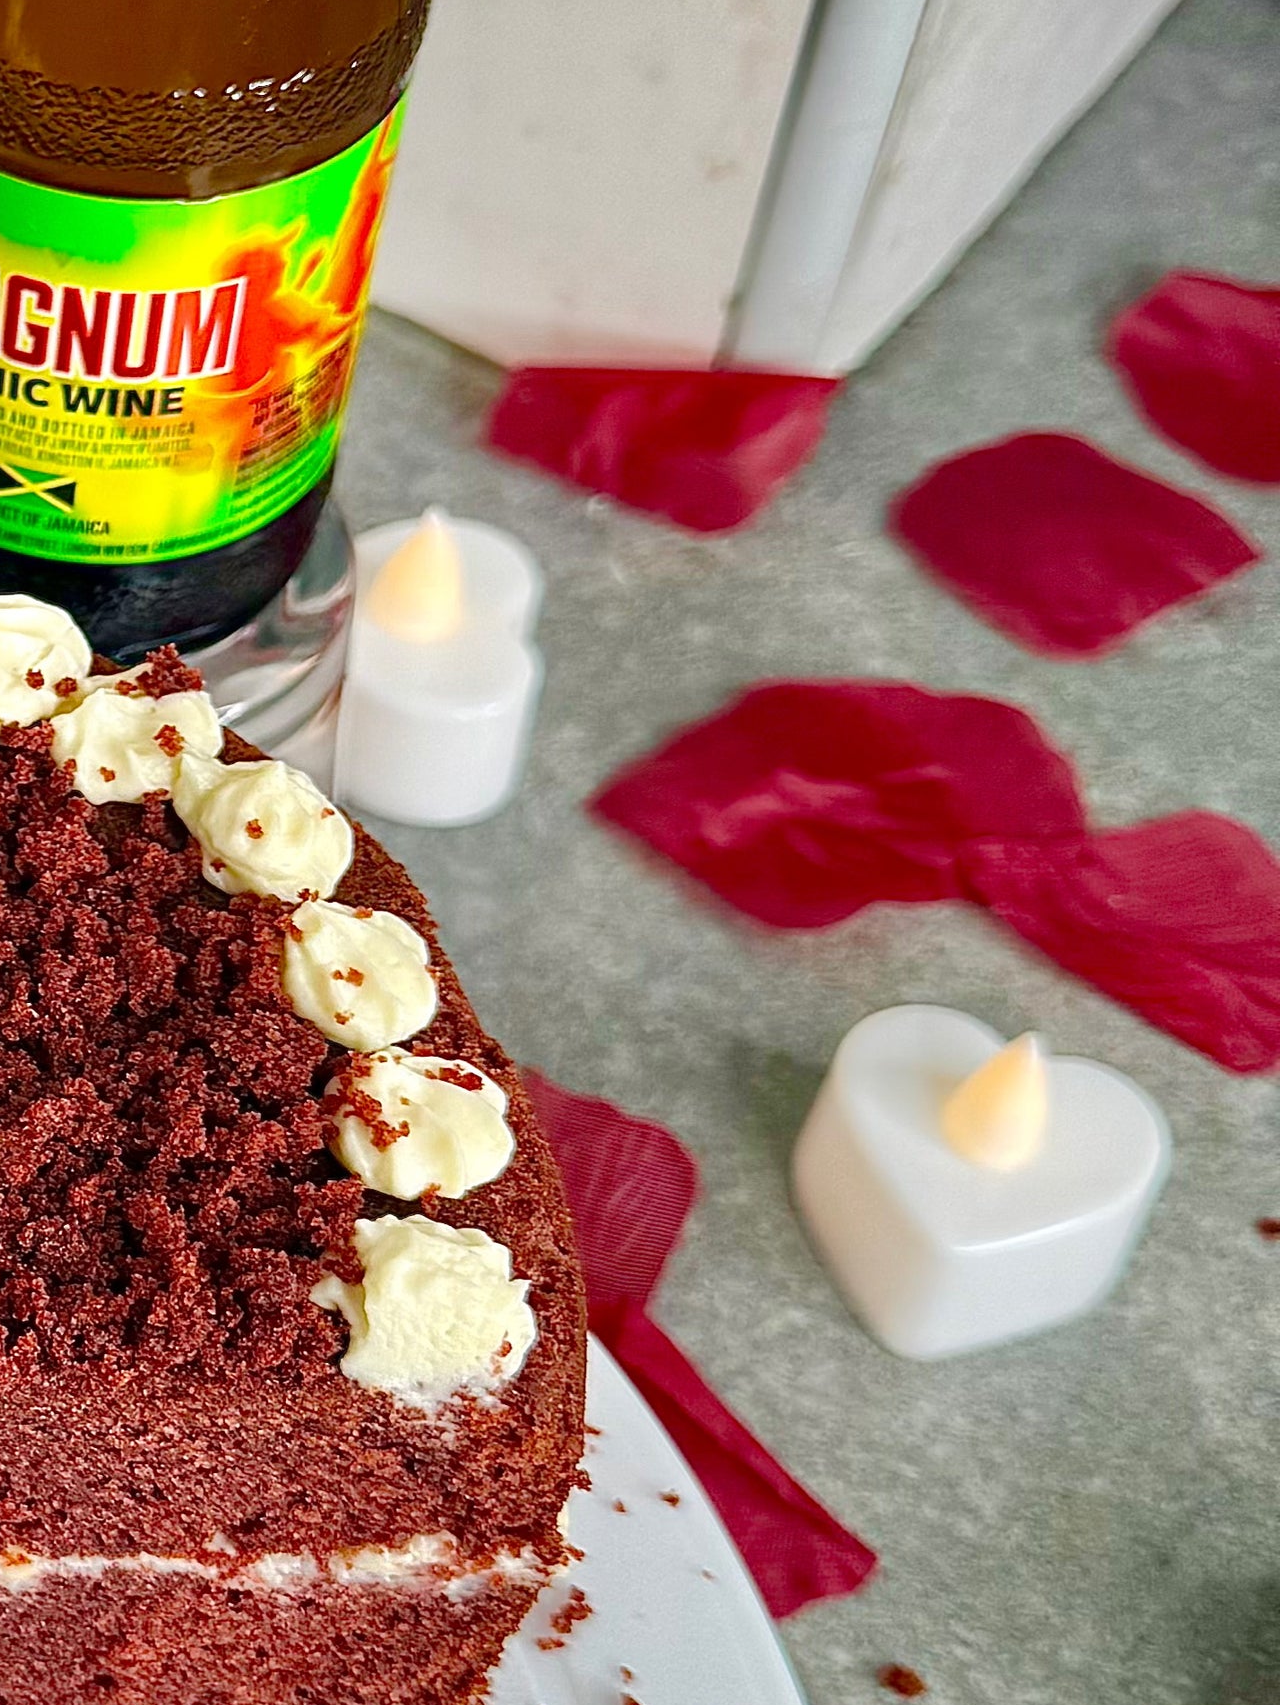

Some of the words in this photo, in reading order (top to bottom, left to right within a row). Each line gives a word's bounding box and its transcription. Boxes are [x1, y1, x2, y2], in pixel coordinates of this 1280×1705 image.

[61, 383, 185, 417] WINE
[9, 410, 37, 430] AND
[41, 417, 106, 440] BOTTLED
[110, 424, 126, 441] IN
[129, 421, 196, 441] JAMAICA
[22, 510, 41, 527] OF
[41, 514, 110, 536] JAMAICA
